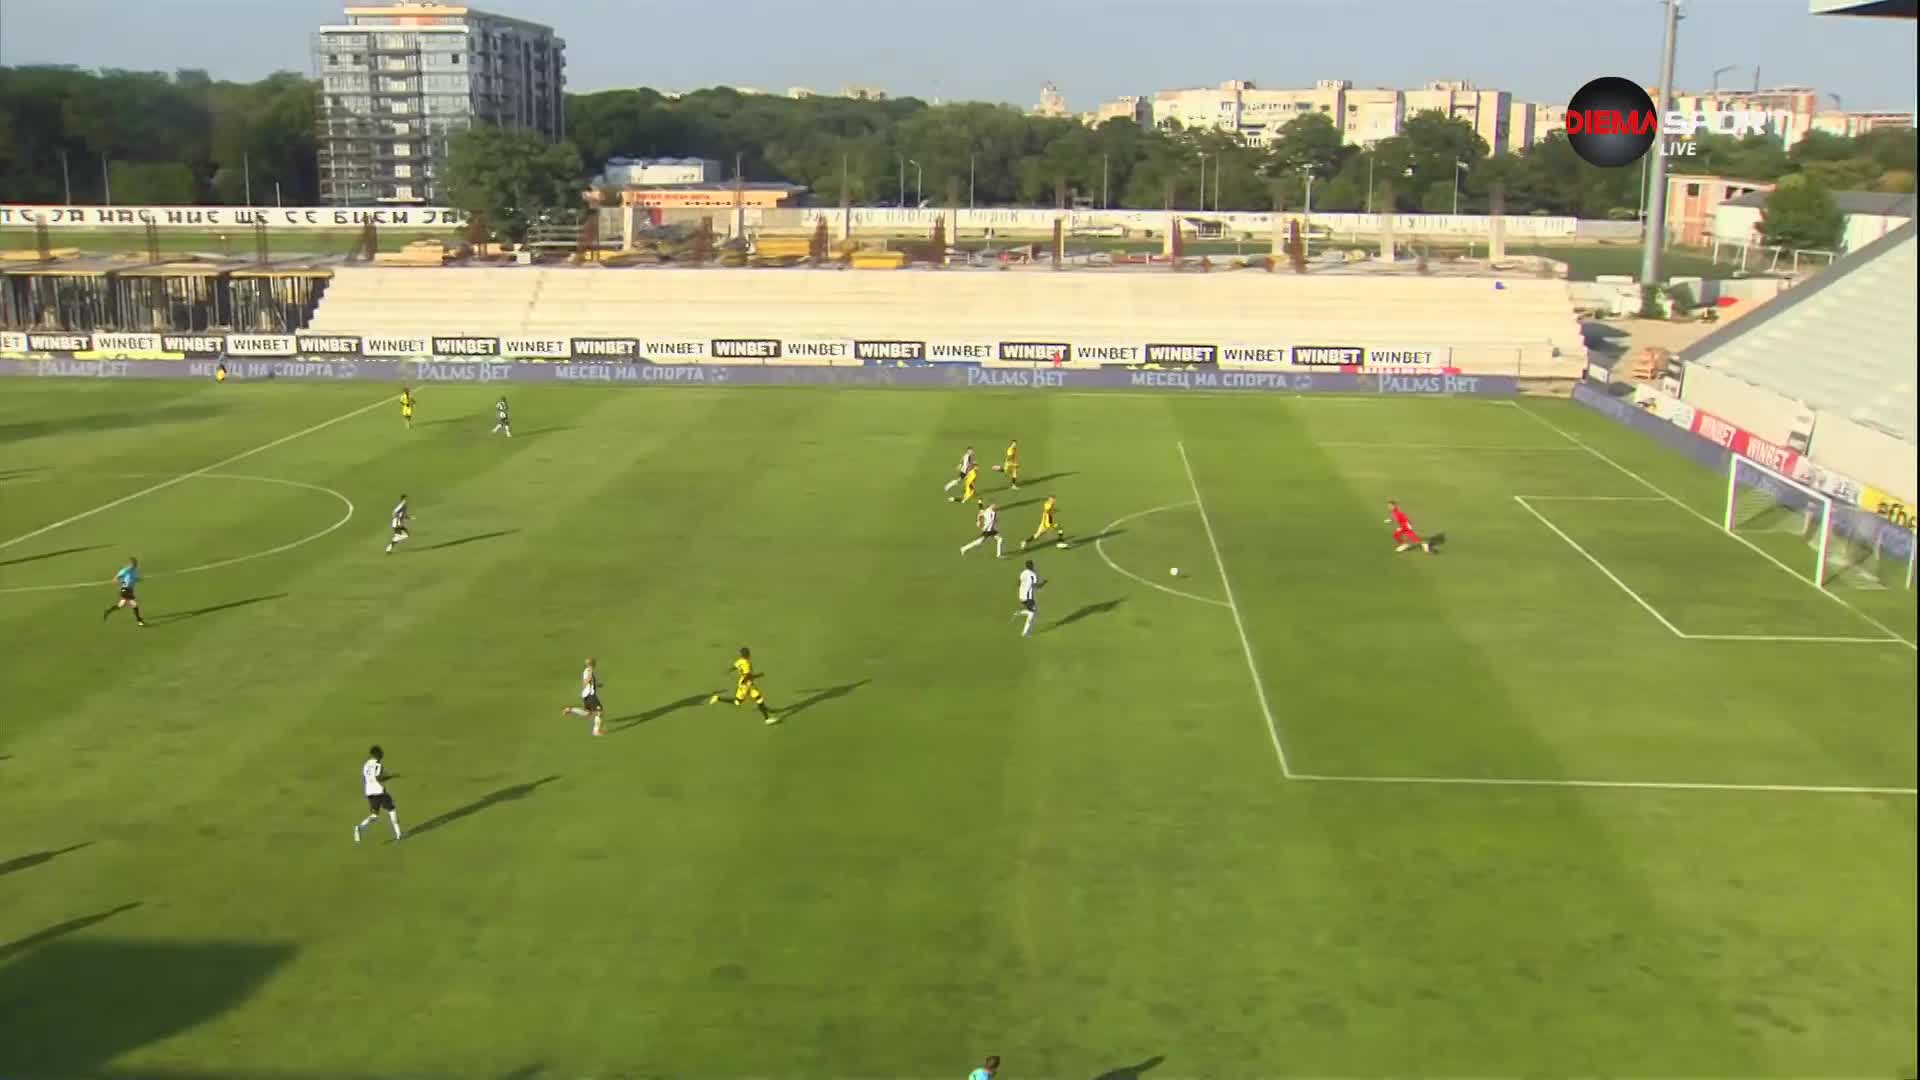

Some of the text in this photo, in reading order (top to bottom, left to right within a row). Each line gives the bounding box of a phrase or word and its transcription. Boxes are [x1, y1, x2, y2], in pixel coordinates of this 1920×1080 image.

[30, 336, 88, 350] WINBET
[99, 337, 154, 350] WINBET
[164, 337, 223, 351] WINBET
[233, 339, 289, 350] WINBET
[300, 338, 359, 352] WINBET
[368, 339, 424, 351] WINBET
[435, 339, 496, 354] WINBET
[506, 341, 563, 352] WINBET
[575, 341, 636, 354] WINBET
[646, 342, 704, 354] WINBET
[716, 342, 778, 356] WINBET
[788, 343, 848, 355] WINBET
[858, 343, 920, 358] WINBET
[932, 345, 992, 357] WINBET
[1078, 347, 1138, 359] WINBET
[1151, 346, 1215, 361] WINBET
[1224, 349, 1284, 361] WINBET
[1296, 350, 1360, 364] WINBET
[1371, 351, 1432, 364] WINBET
[556, 366, 704, 382] МЕСЕЦ НА СПОРТА
[1132, 372, 1287, 389] МЕСЕЦ НА СПОРТА
